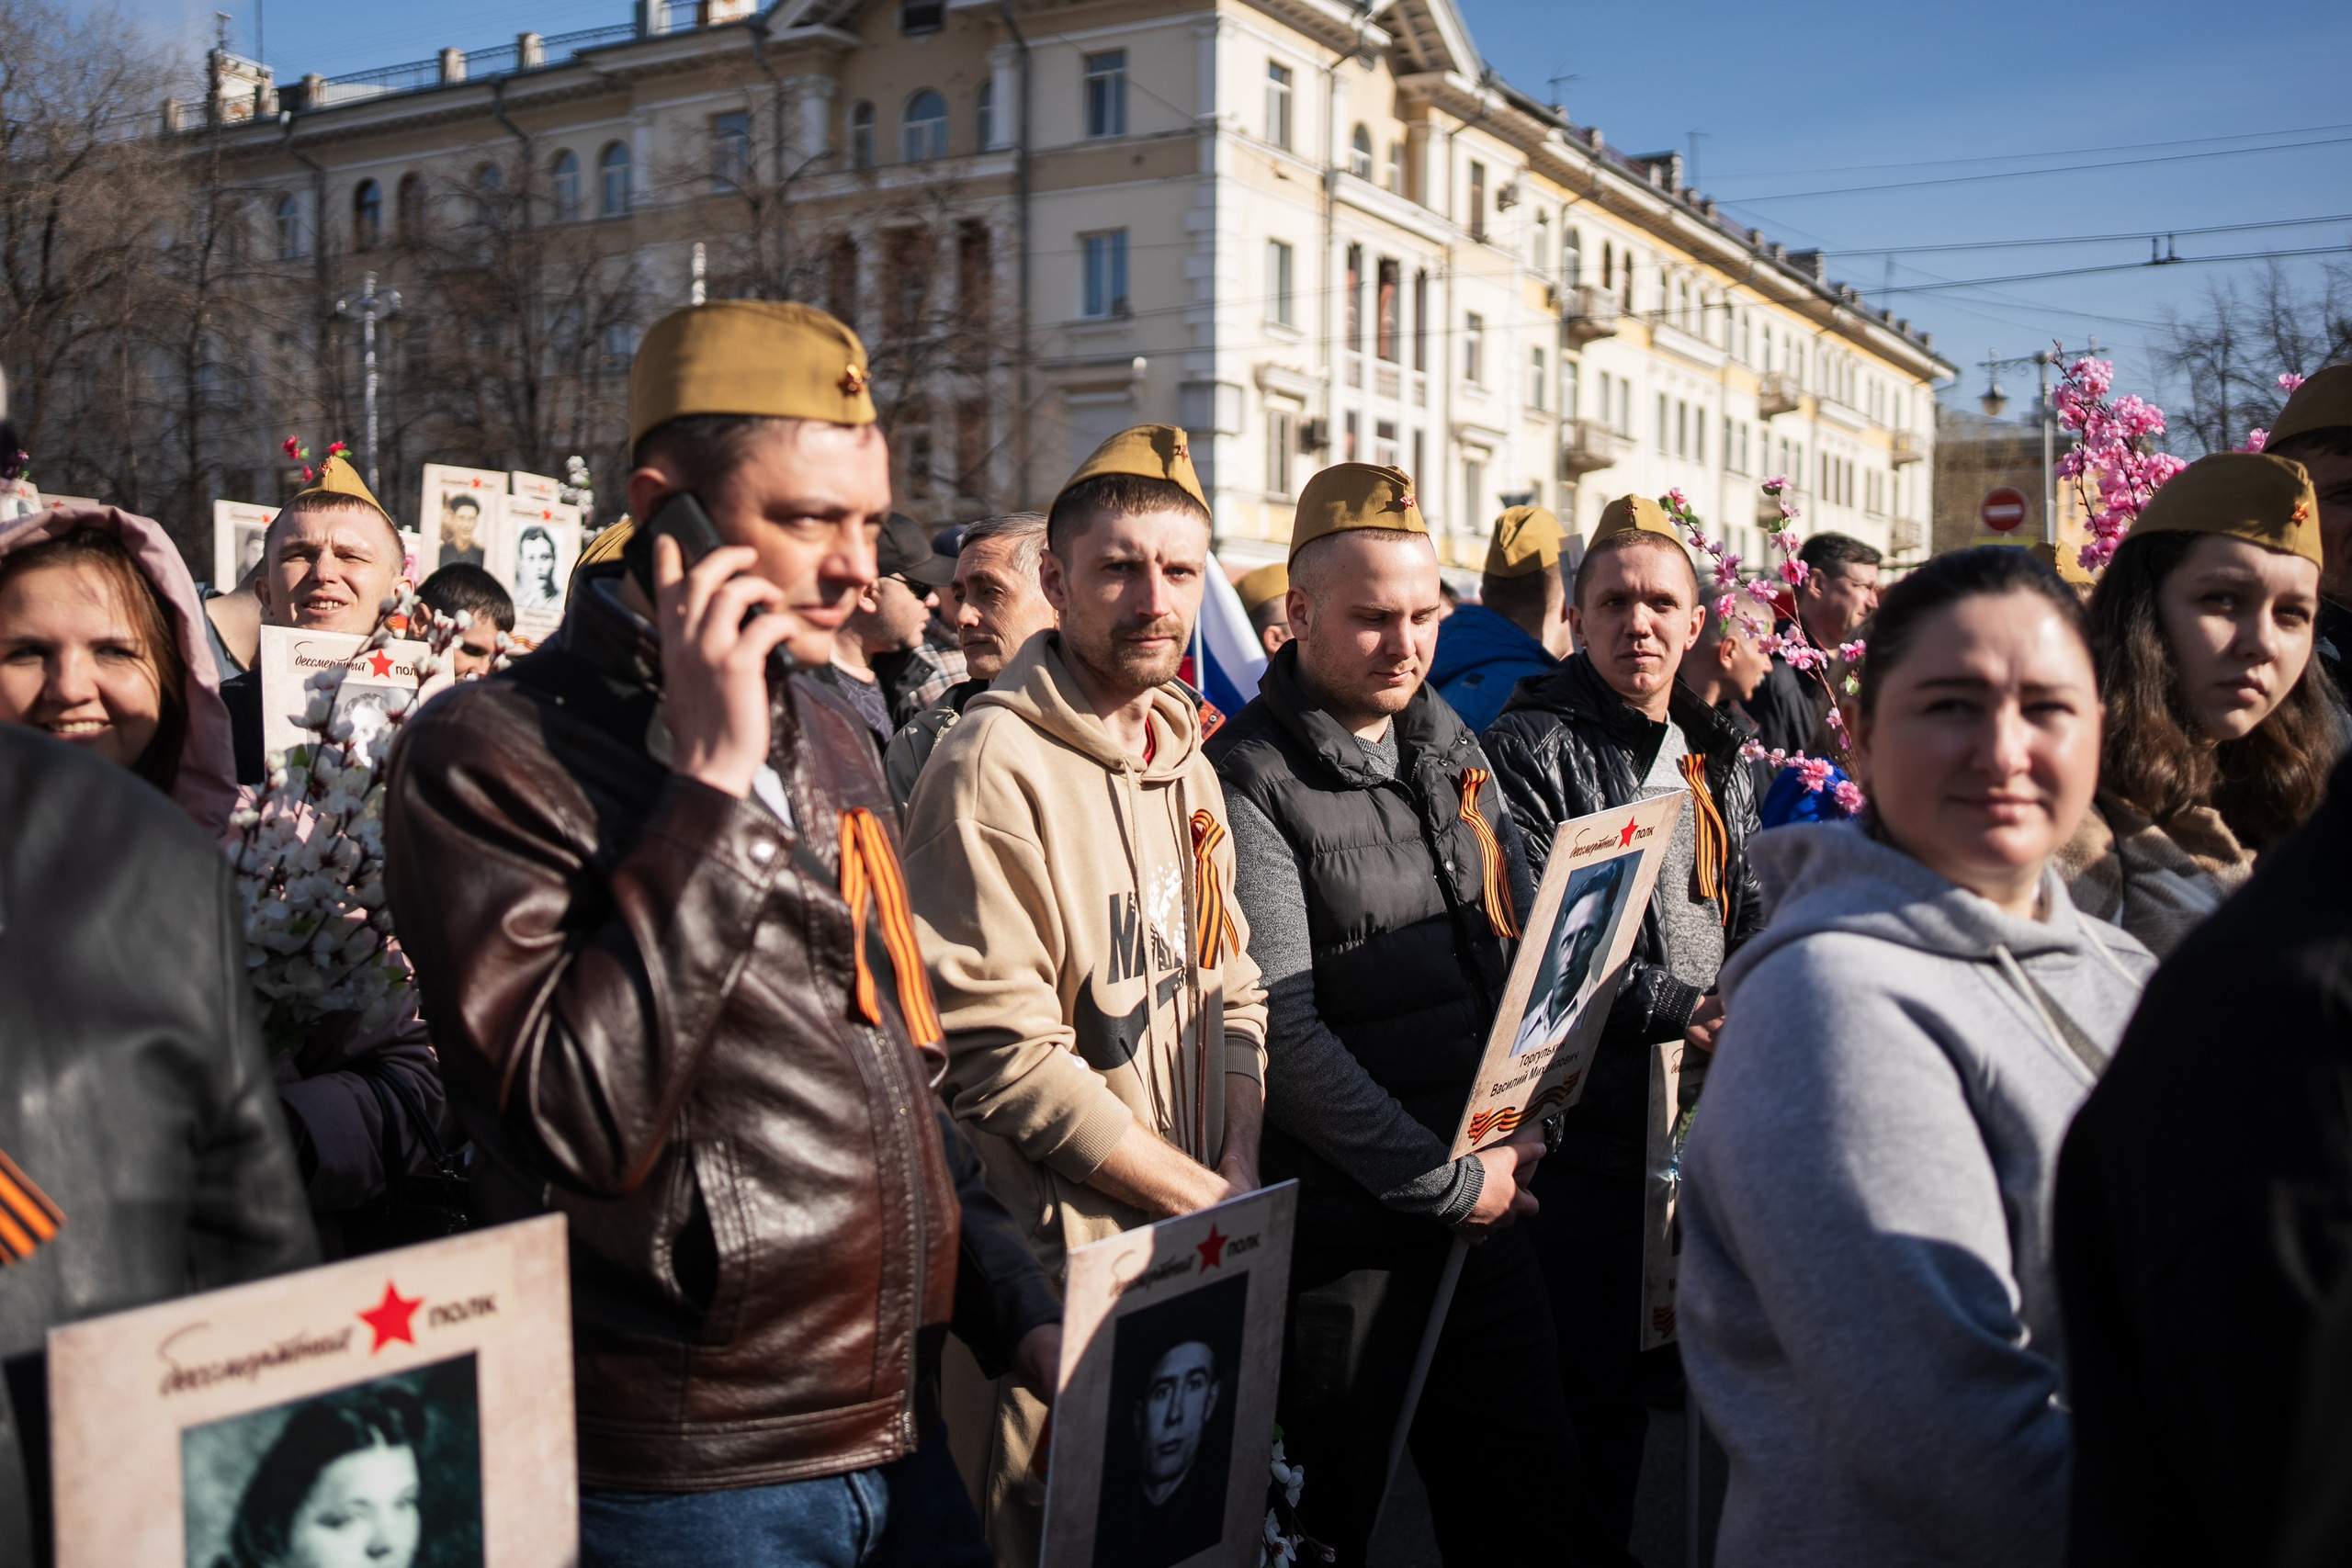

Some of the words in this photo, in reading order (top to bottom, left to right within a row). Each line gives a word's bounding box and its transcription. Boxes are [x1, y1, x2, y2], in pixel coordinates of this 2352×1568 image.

[395, 665, 417, 676] пол
[1569, 828, 1619, 859] бессмертный
[1634, 826, 1655, 840] полк
[1519, 1040, 1567, 1067] Торгулькин
[1490, 1070, 1529, 1098] Василий
[1528, 1051, 1579, 1081] Михайлович
[1227, 1234, 1261, 1257] полк
[428, 1294, 498, 1327] полк
